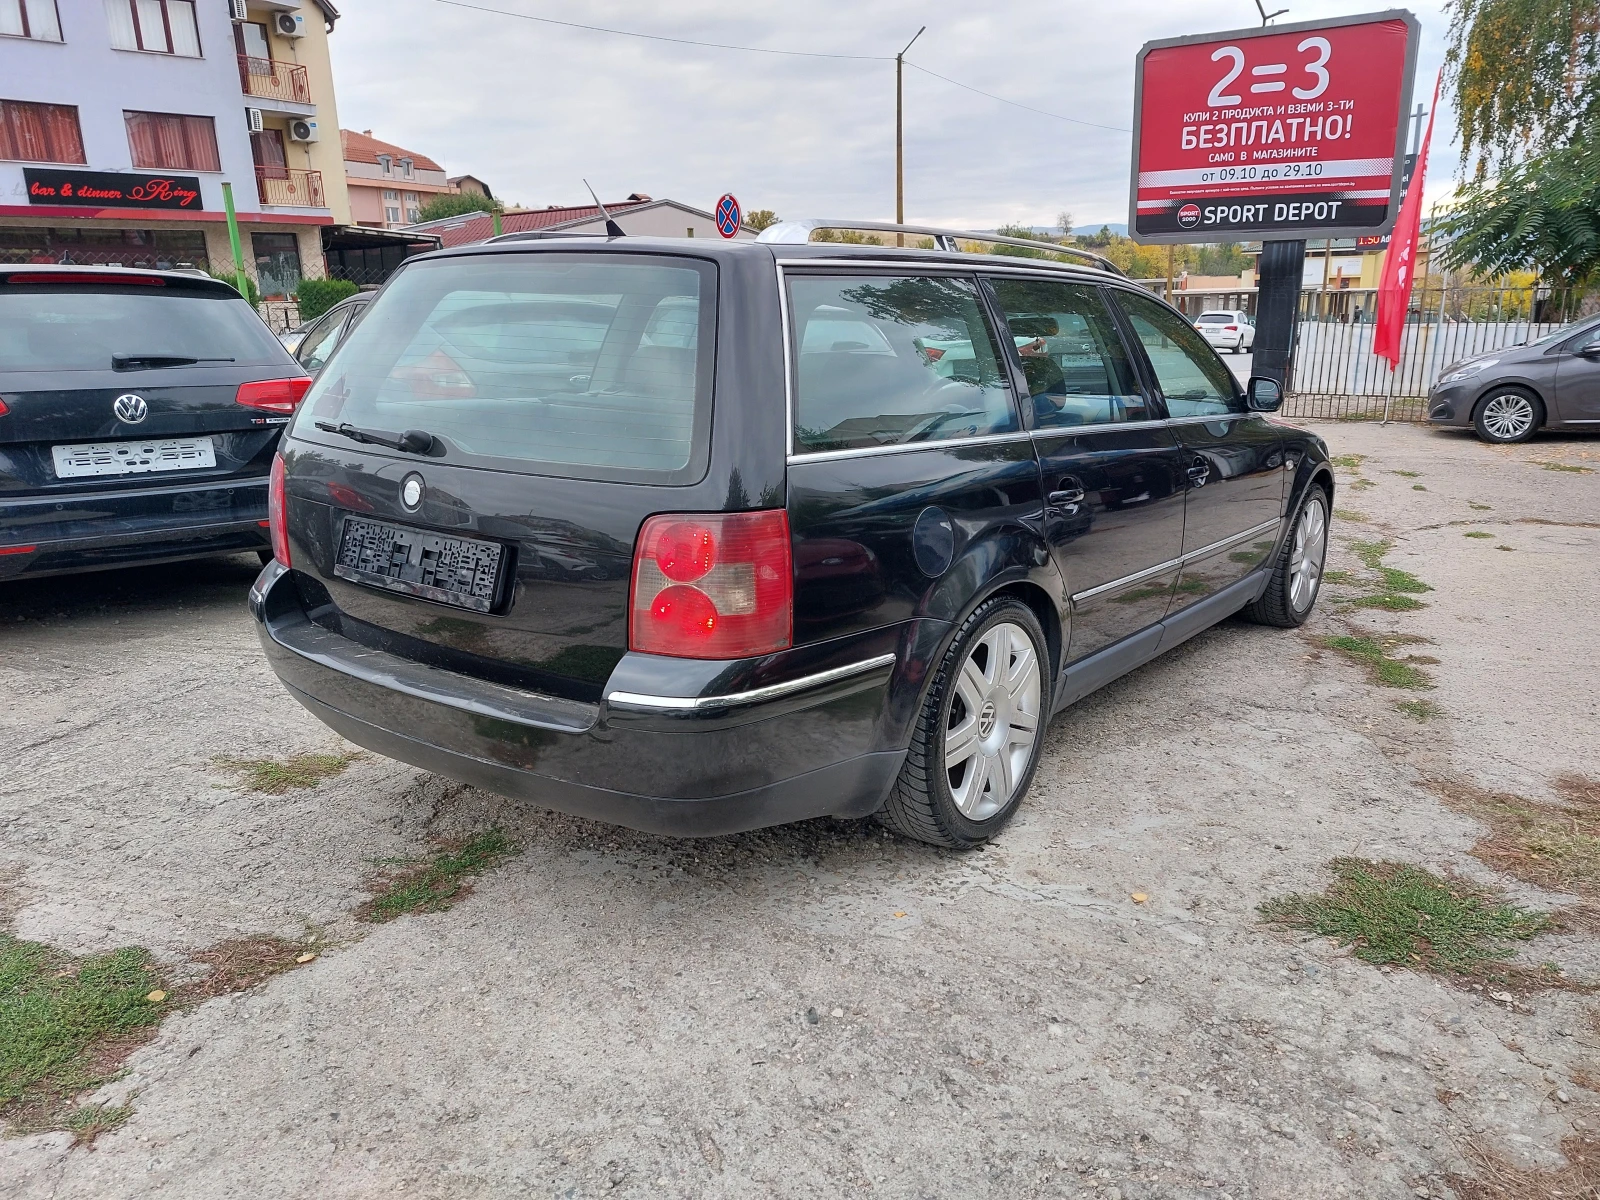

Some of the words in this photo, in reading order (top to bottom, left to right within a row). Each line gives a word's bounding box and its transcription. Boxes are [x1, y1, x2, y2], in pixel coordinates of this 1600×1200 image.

[1207, 37, 1332, 107] 2=3
[1184, 111, 1210, 122] КУПИ
[1213, 111, 1219, 120] 2
[1222, 106, 1274, 120] ПРОДУКТА
[1277, 105, 1285, 115] И
[1288, 103, 1324, 114] ВЗЕМИ
[1327, 100, 1354, 111] 3-ТИ
[1181, 115, 1352, 150] БЕЗПЛАТНО!
[1208, 152, 1234, 163] САМО
[1241, 151, 1247, 160] В
[1253, 147, 1318, 160] МАГАЗИНИТЕ
[1202, 172, 1215, 182] от
[1220, 167, 1257, 180] 09.10
[1261, 169, 1279, 180] до
[1283, 163, 1323, 177] 29.10
[31, 182, 55, 196] bar
[61, 183, 73, 196] &
[78, 186, 122, 199] dinner
[126, 179, 197, 206] Ring
[1204, 204, 1268, 224] SPORT
[1274, 202, 1342, 221] DEPOT
